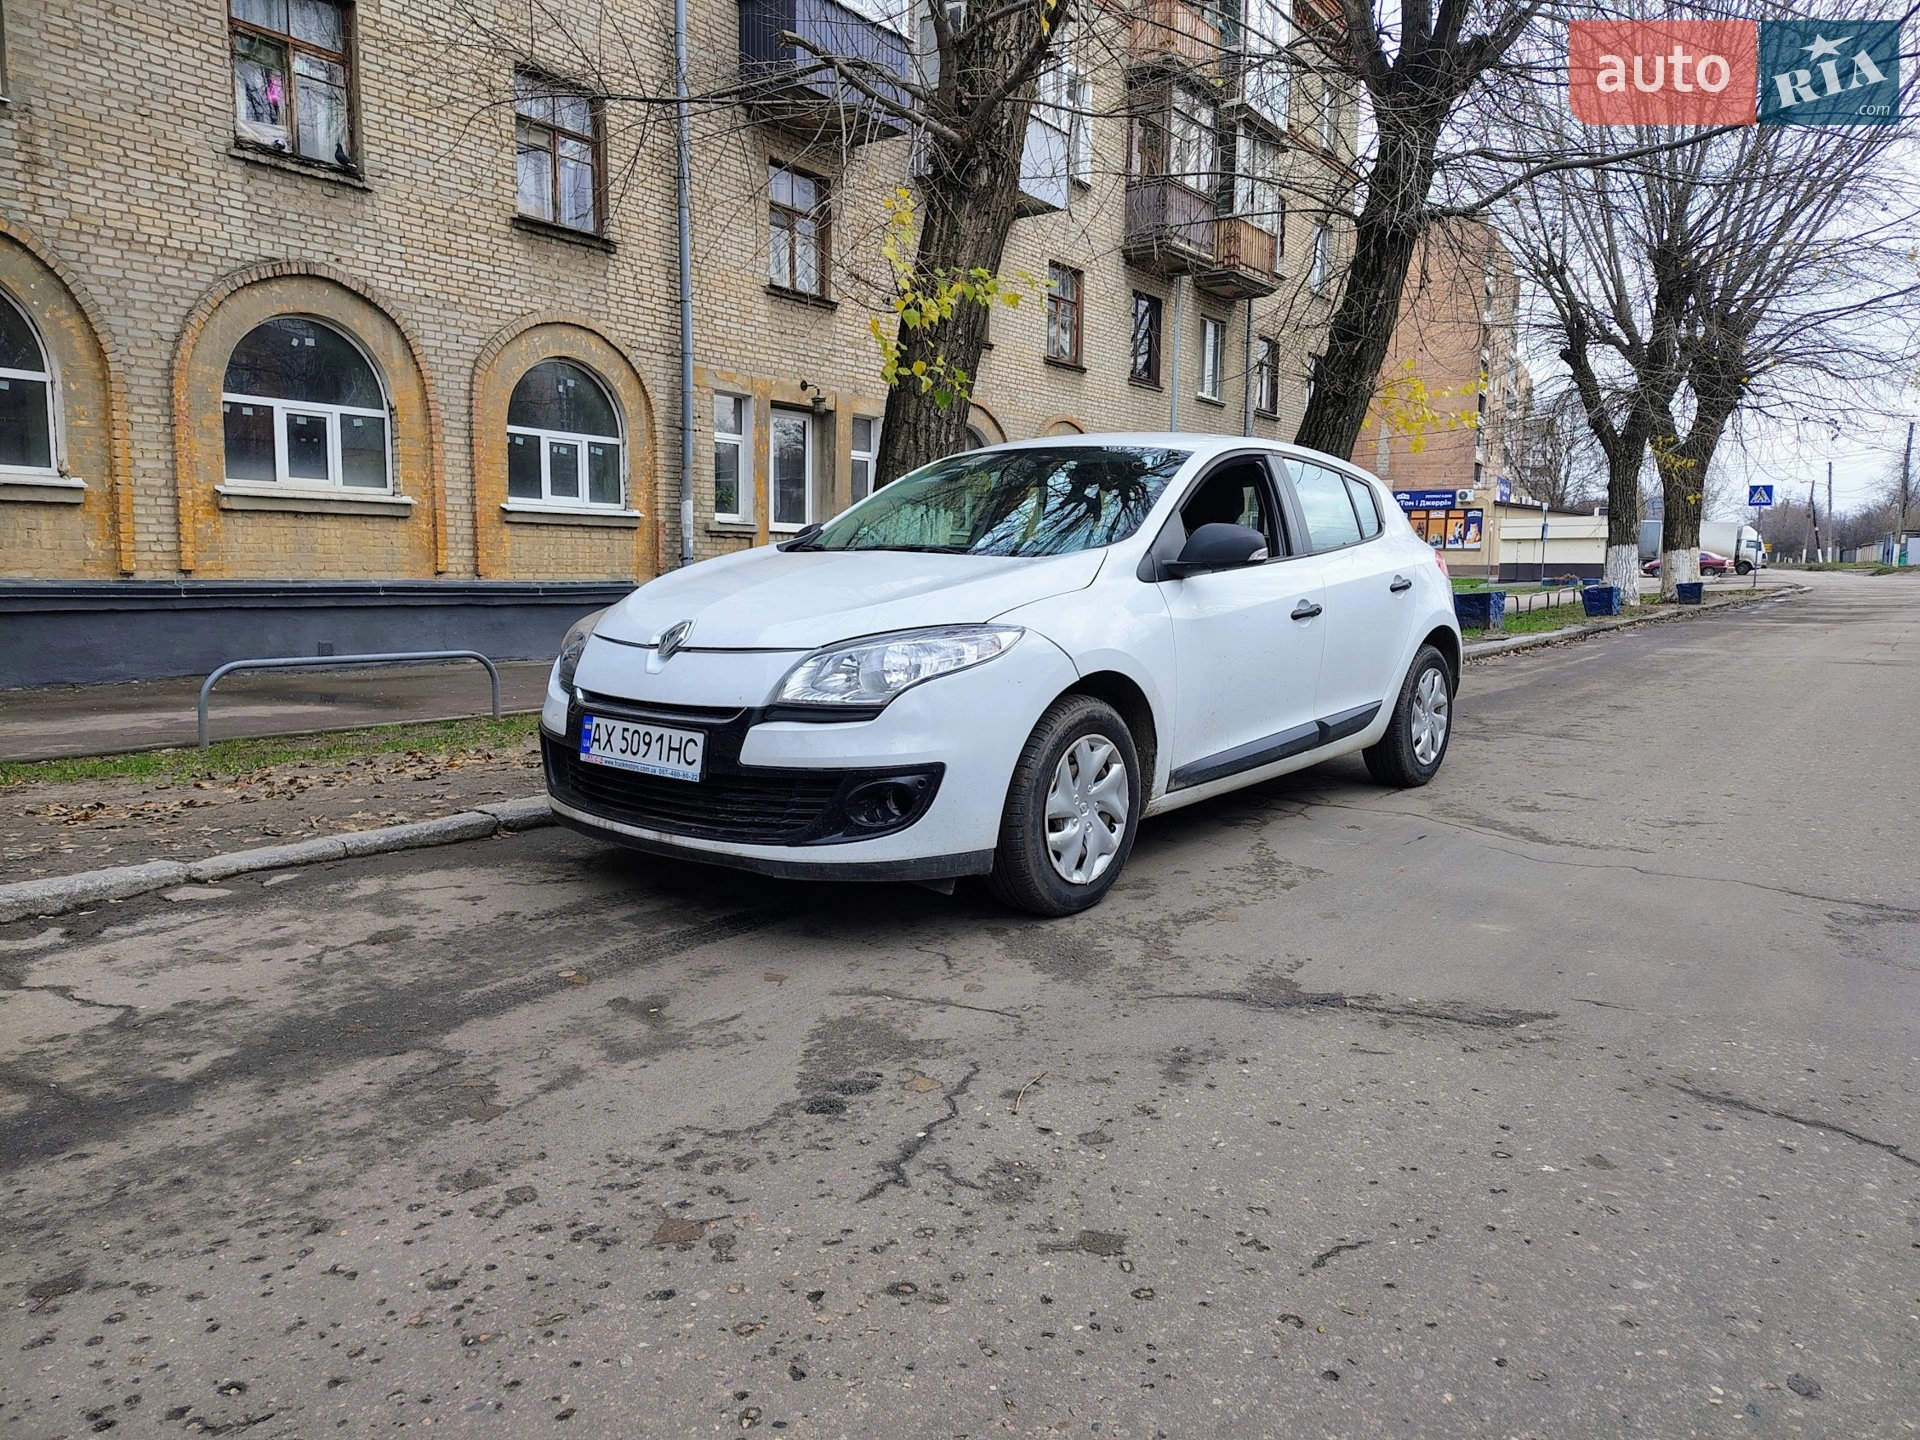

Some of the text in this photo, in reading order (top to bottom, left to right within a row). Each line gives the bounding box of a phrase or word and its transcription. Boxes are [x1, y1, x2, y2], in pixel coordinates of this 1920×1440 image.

[583, 739, 590, 747] UA
[591, 723, 698, 766] AX 5091HC
